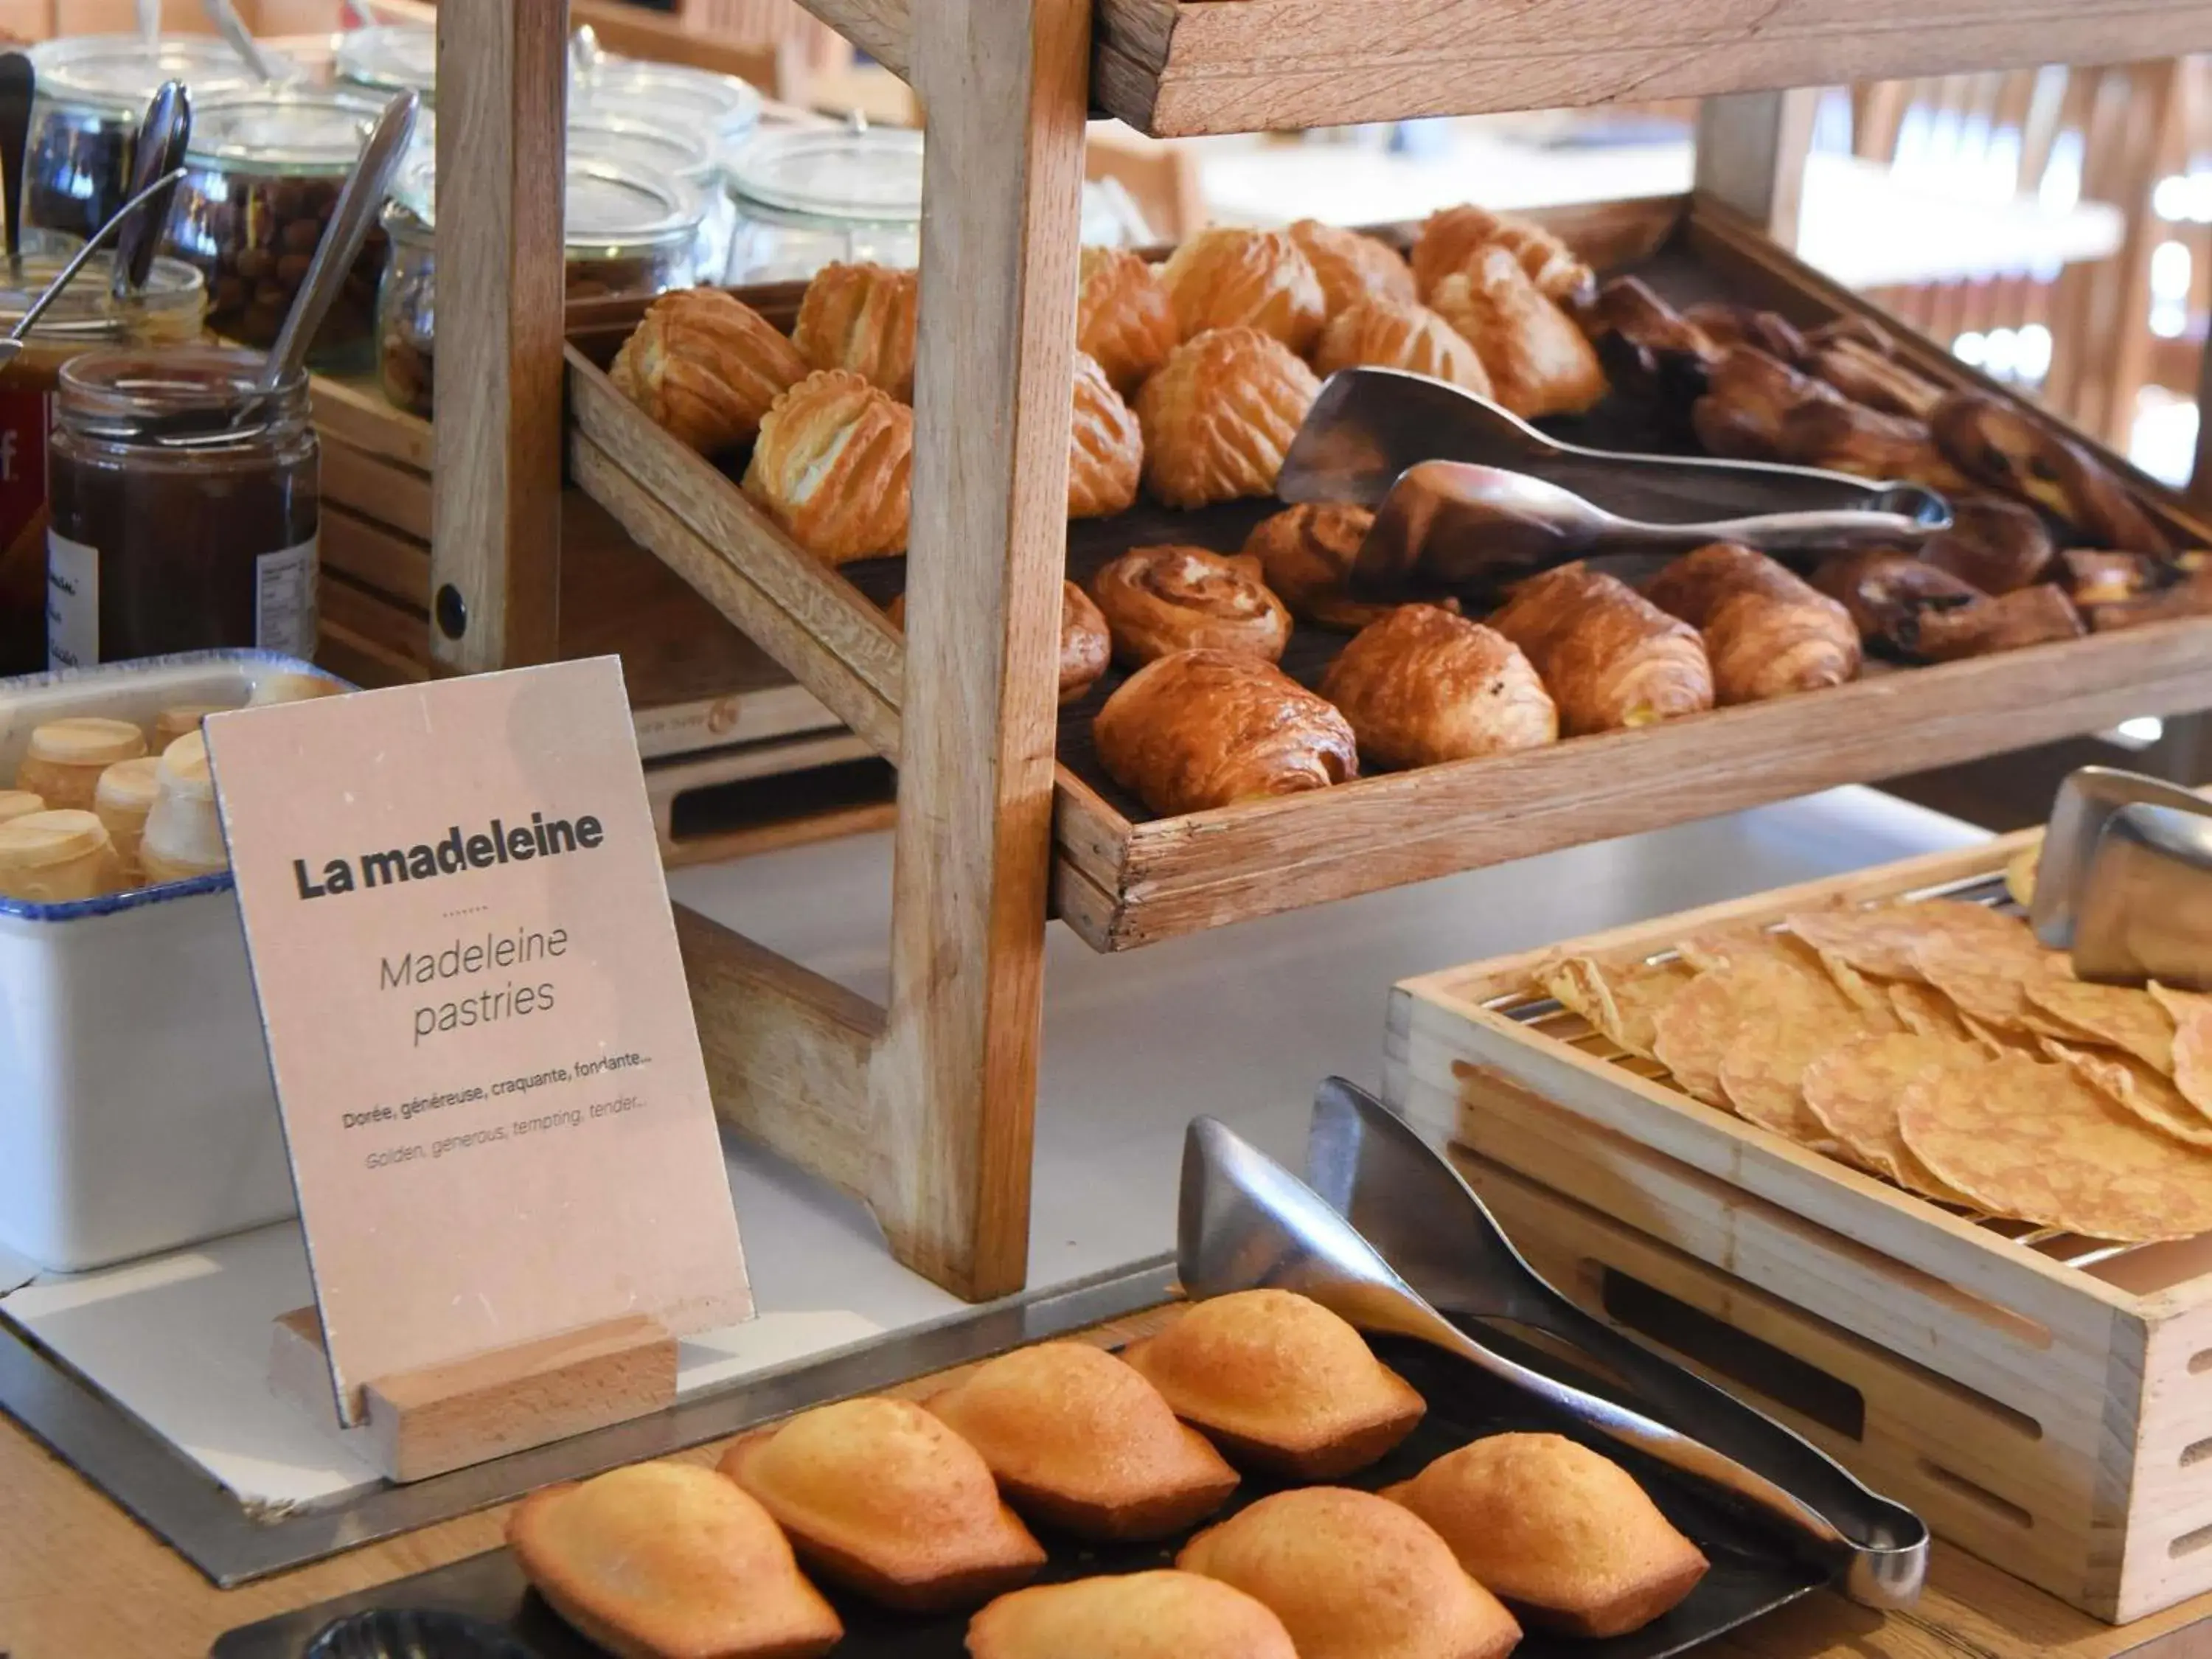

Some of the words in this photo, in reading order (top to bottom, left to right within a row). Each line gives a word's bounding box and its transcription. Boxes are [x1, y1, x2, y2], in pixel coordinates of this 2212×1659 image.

[293, 858, 355, 900] La
[360, 812, 604, 888] madeleine
[380, 927, 568, 990] Madeleine
[413, 981, 554, 1047] pastries
[342, 1105, 397, 1130] Dorée,
[402, 1088, 488, 1120] généreuse,
[491, 1065, 572, 1094] craquante,
[431, 1124, 509, 1158] generous,
[513, 1109, 585, 1136] tempting,
